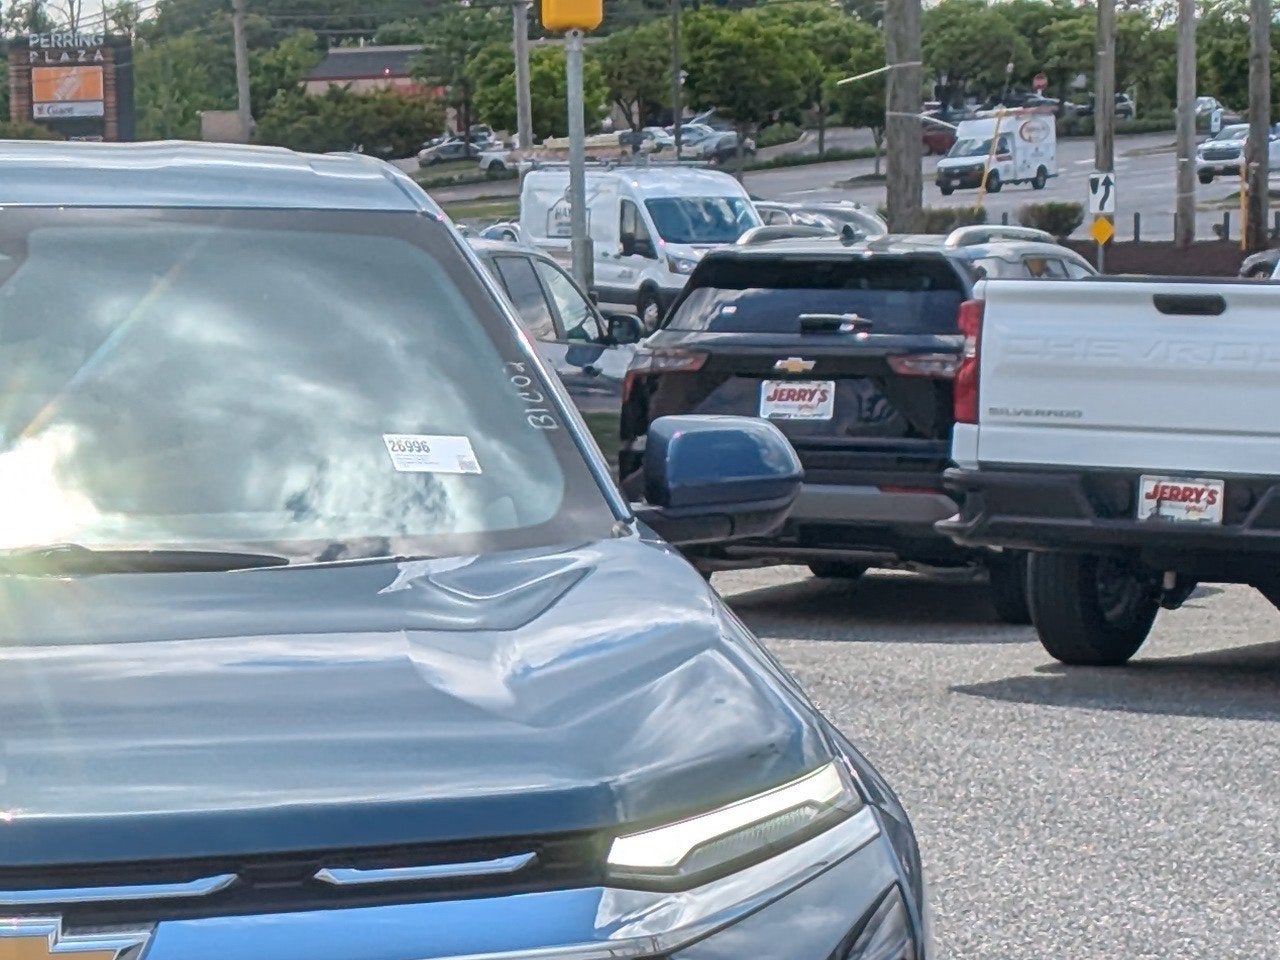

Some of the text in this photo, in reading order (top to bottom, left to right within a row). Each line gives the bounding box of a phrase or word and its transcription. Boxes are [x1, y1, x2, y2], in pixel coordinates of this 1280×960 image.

[29, 31, 104, 48] PERRING
[29, 49, 104, 63] PLAZA
[766, 391, 829, 403] JERRY'S
[1145, 485, 1219, 505] JERRY'S
